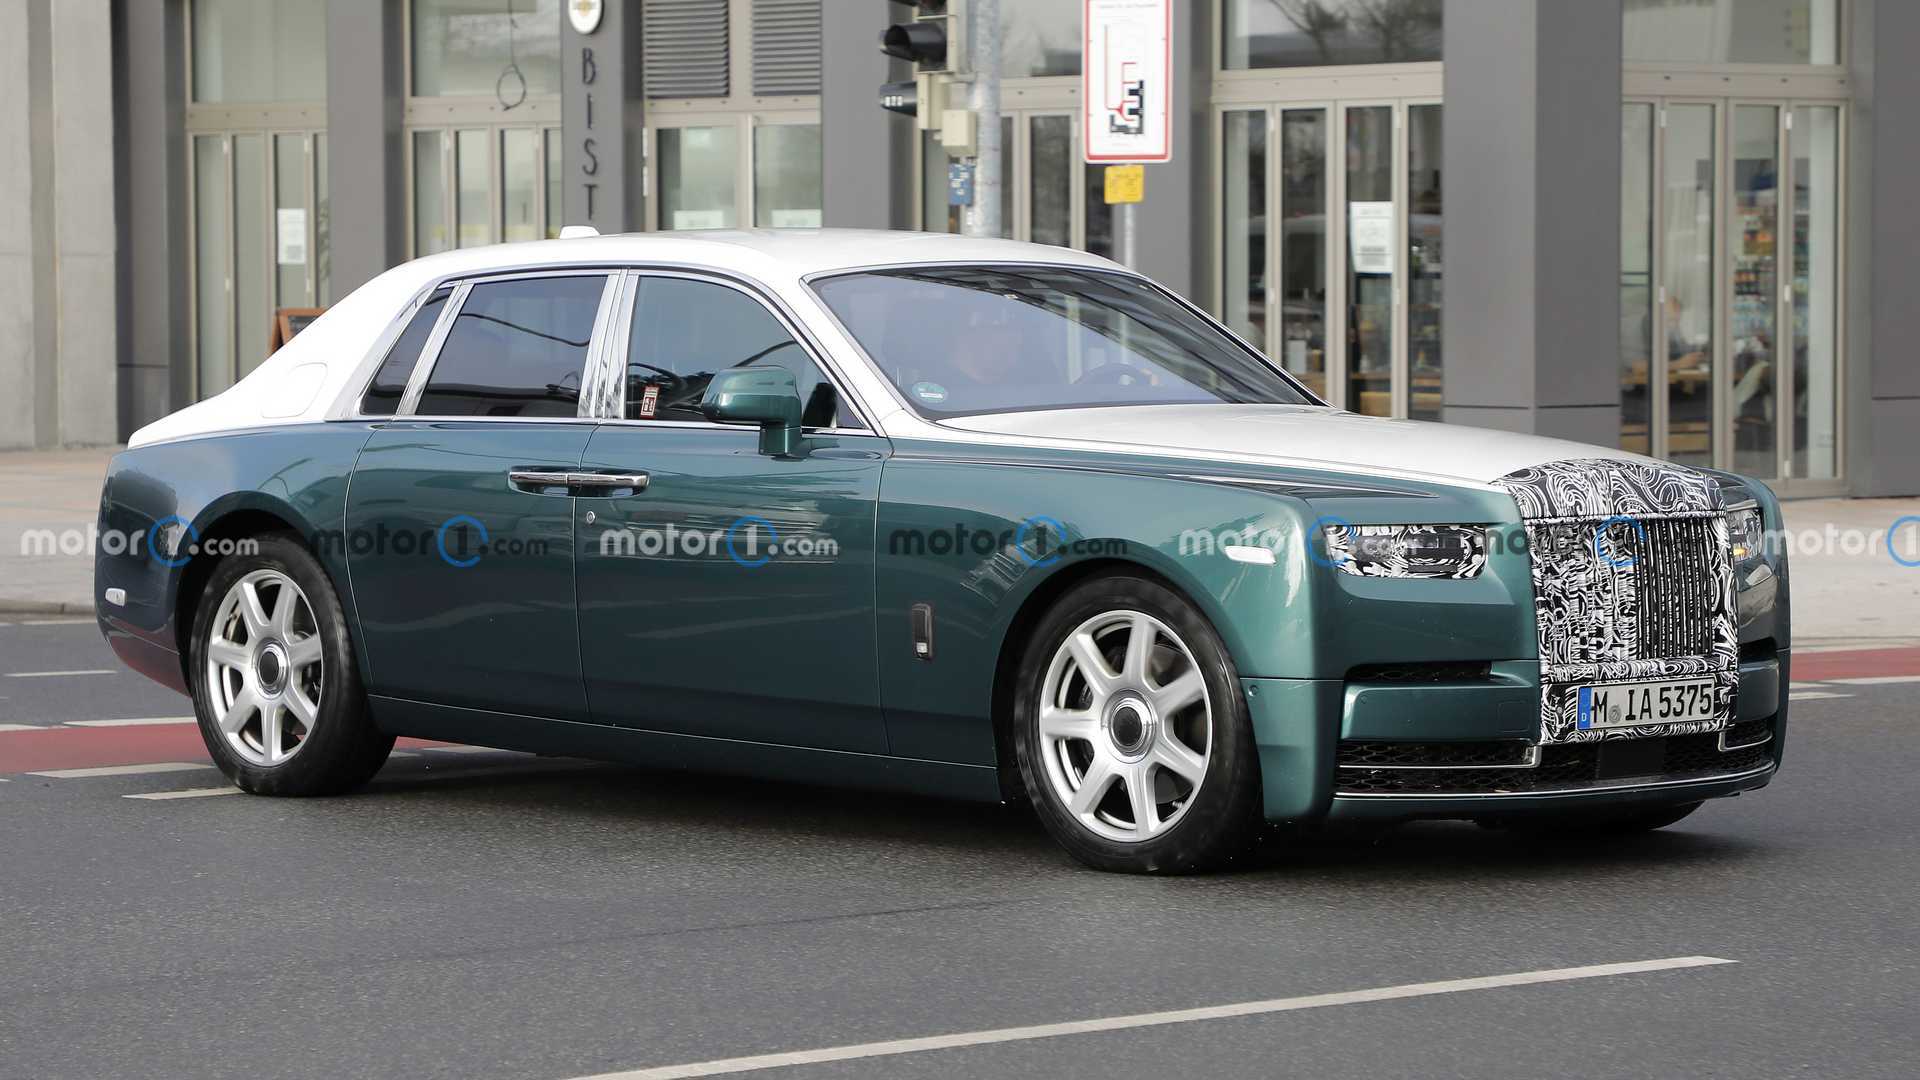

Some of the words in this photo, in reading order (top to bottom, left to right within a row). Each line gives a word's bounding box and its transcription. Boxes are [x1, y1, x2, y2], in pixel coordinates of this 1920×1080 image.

[1593, 691, 1608, 723] M
[1625, 688, 1653, 721] IA
[1658, 683, 1713, 719] 5375
